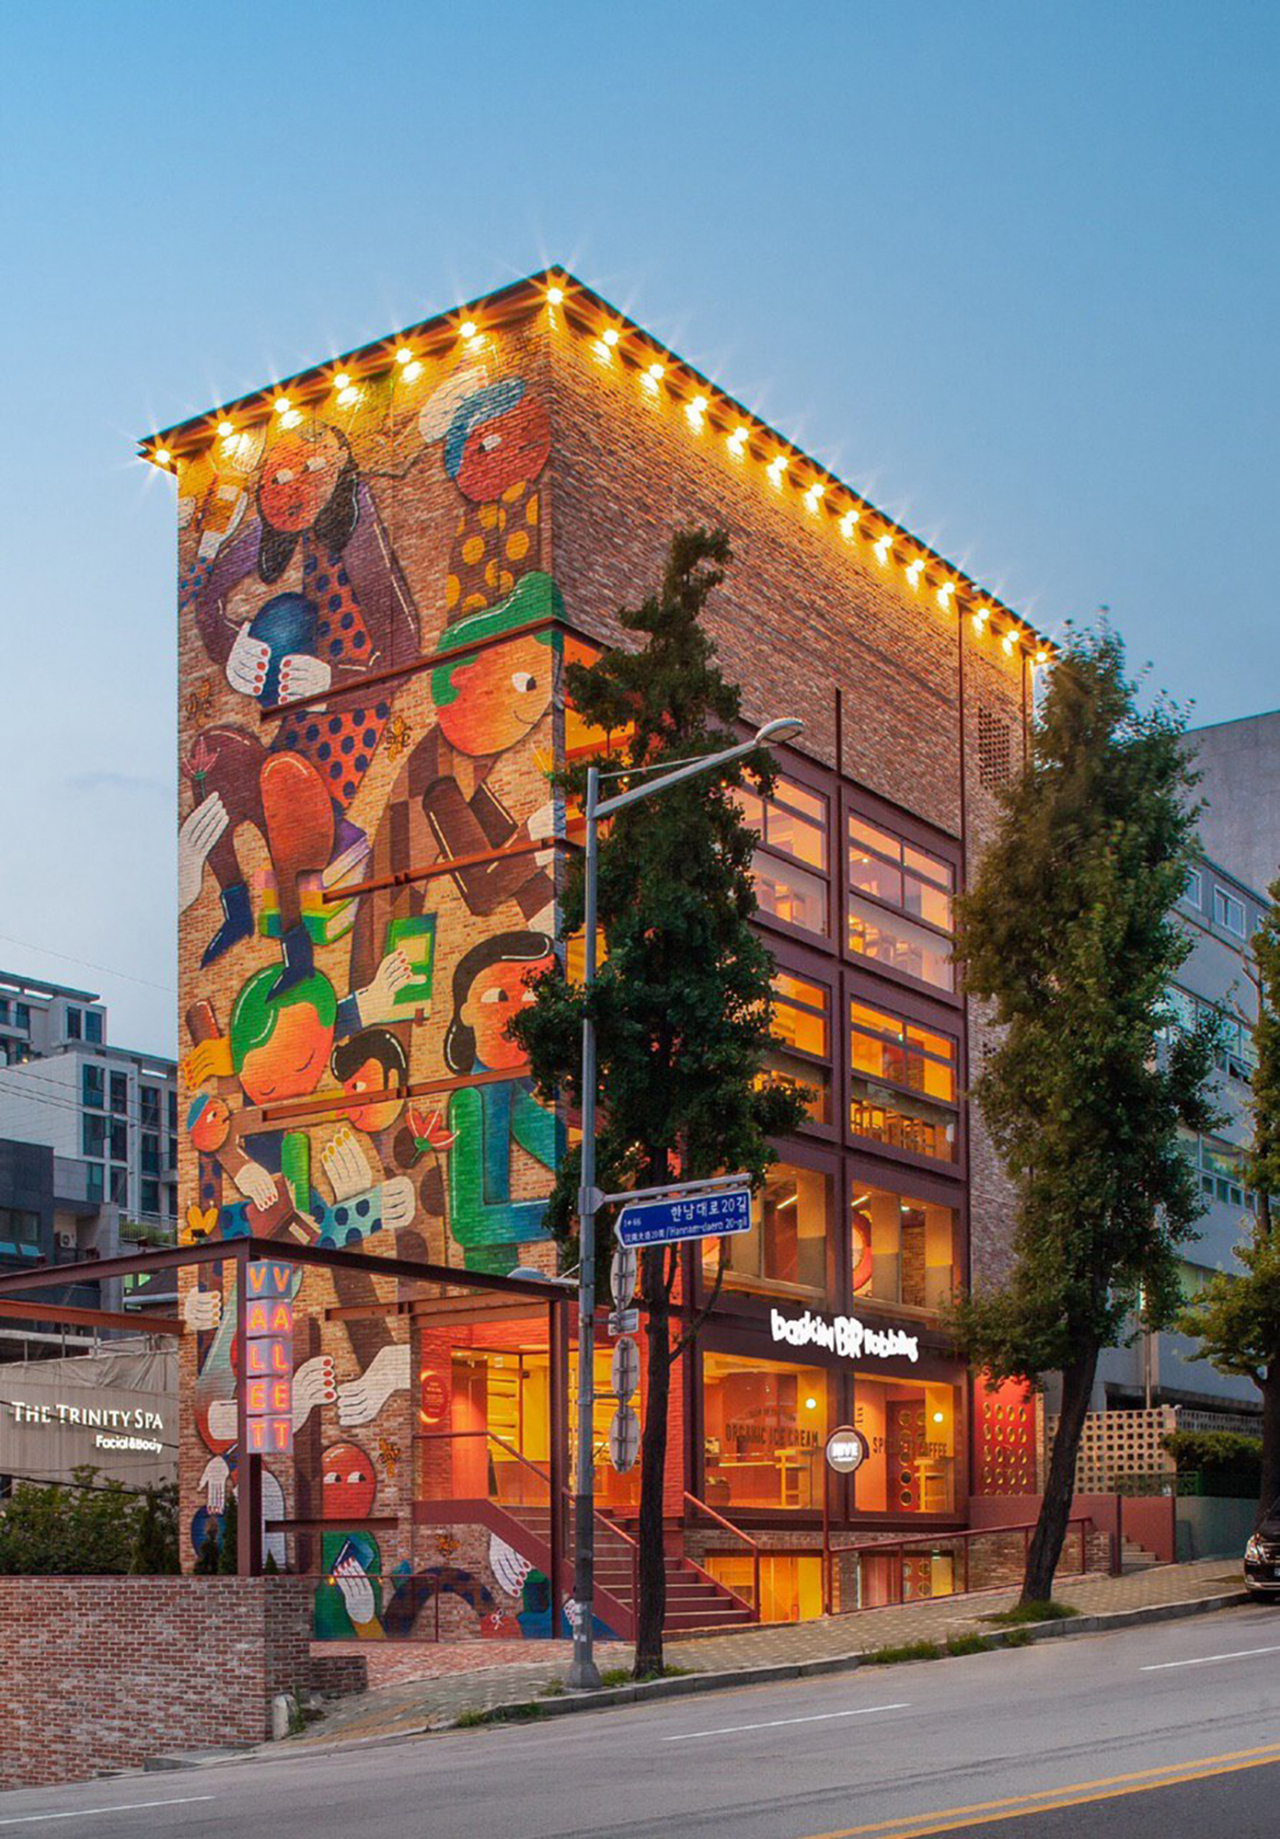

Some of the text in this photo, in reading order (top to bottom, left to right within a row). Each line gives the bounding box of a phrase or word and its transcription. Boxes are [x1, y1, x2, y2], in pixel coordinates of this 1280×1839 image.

[11, 1401, 164, 1430] THE TRINITY SPA
